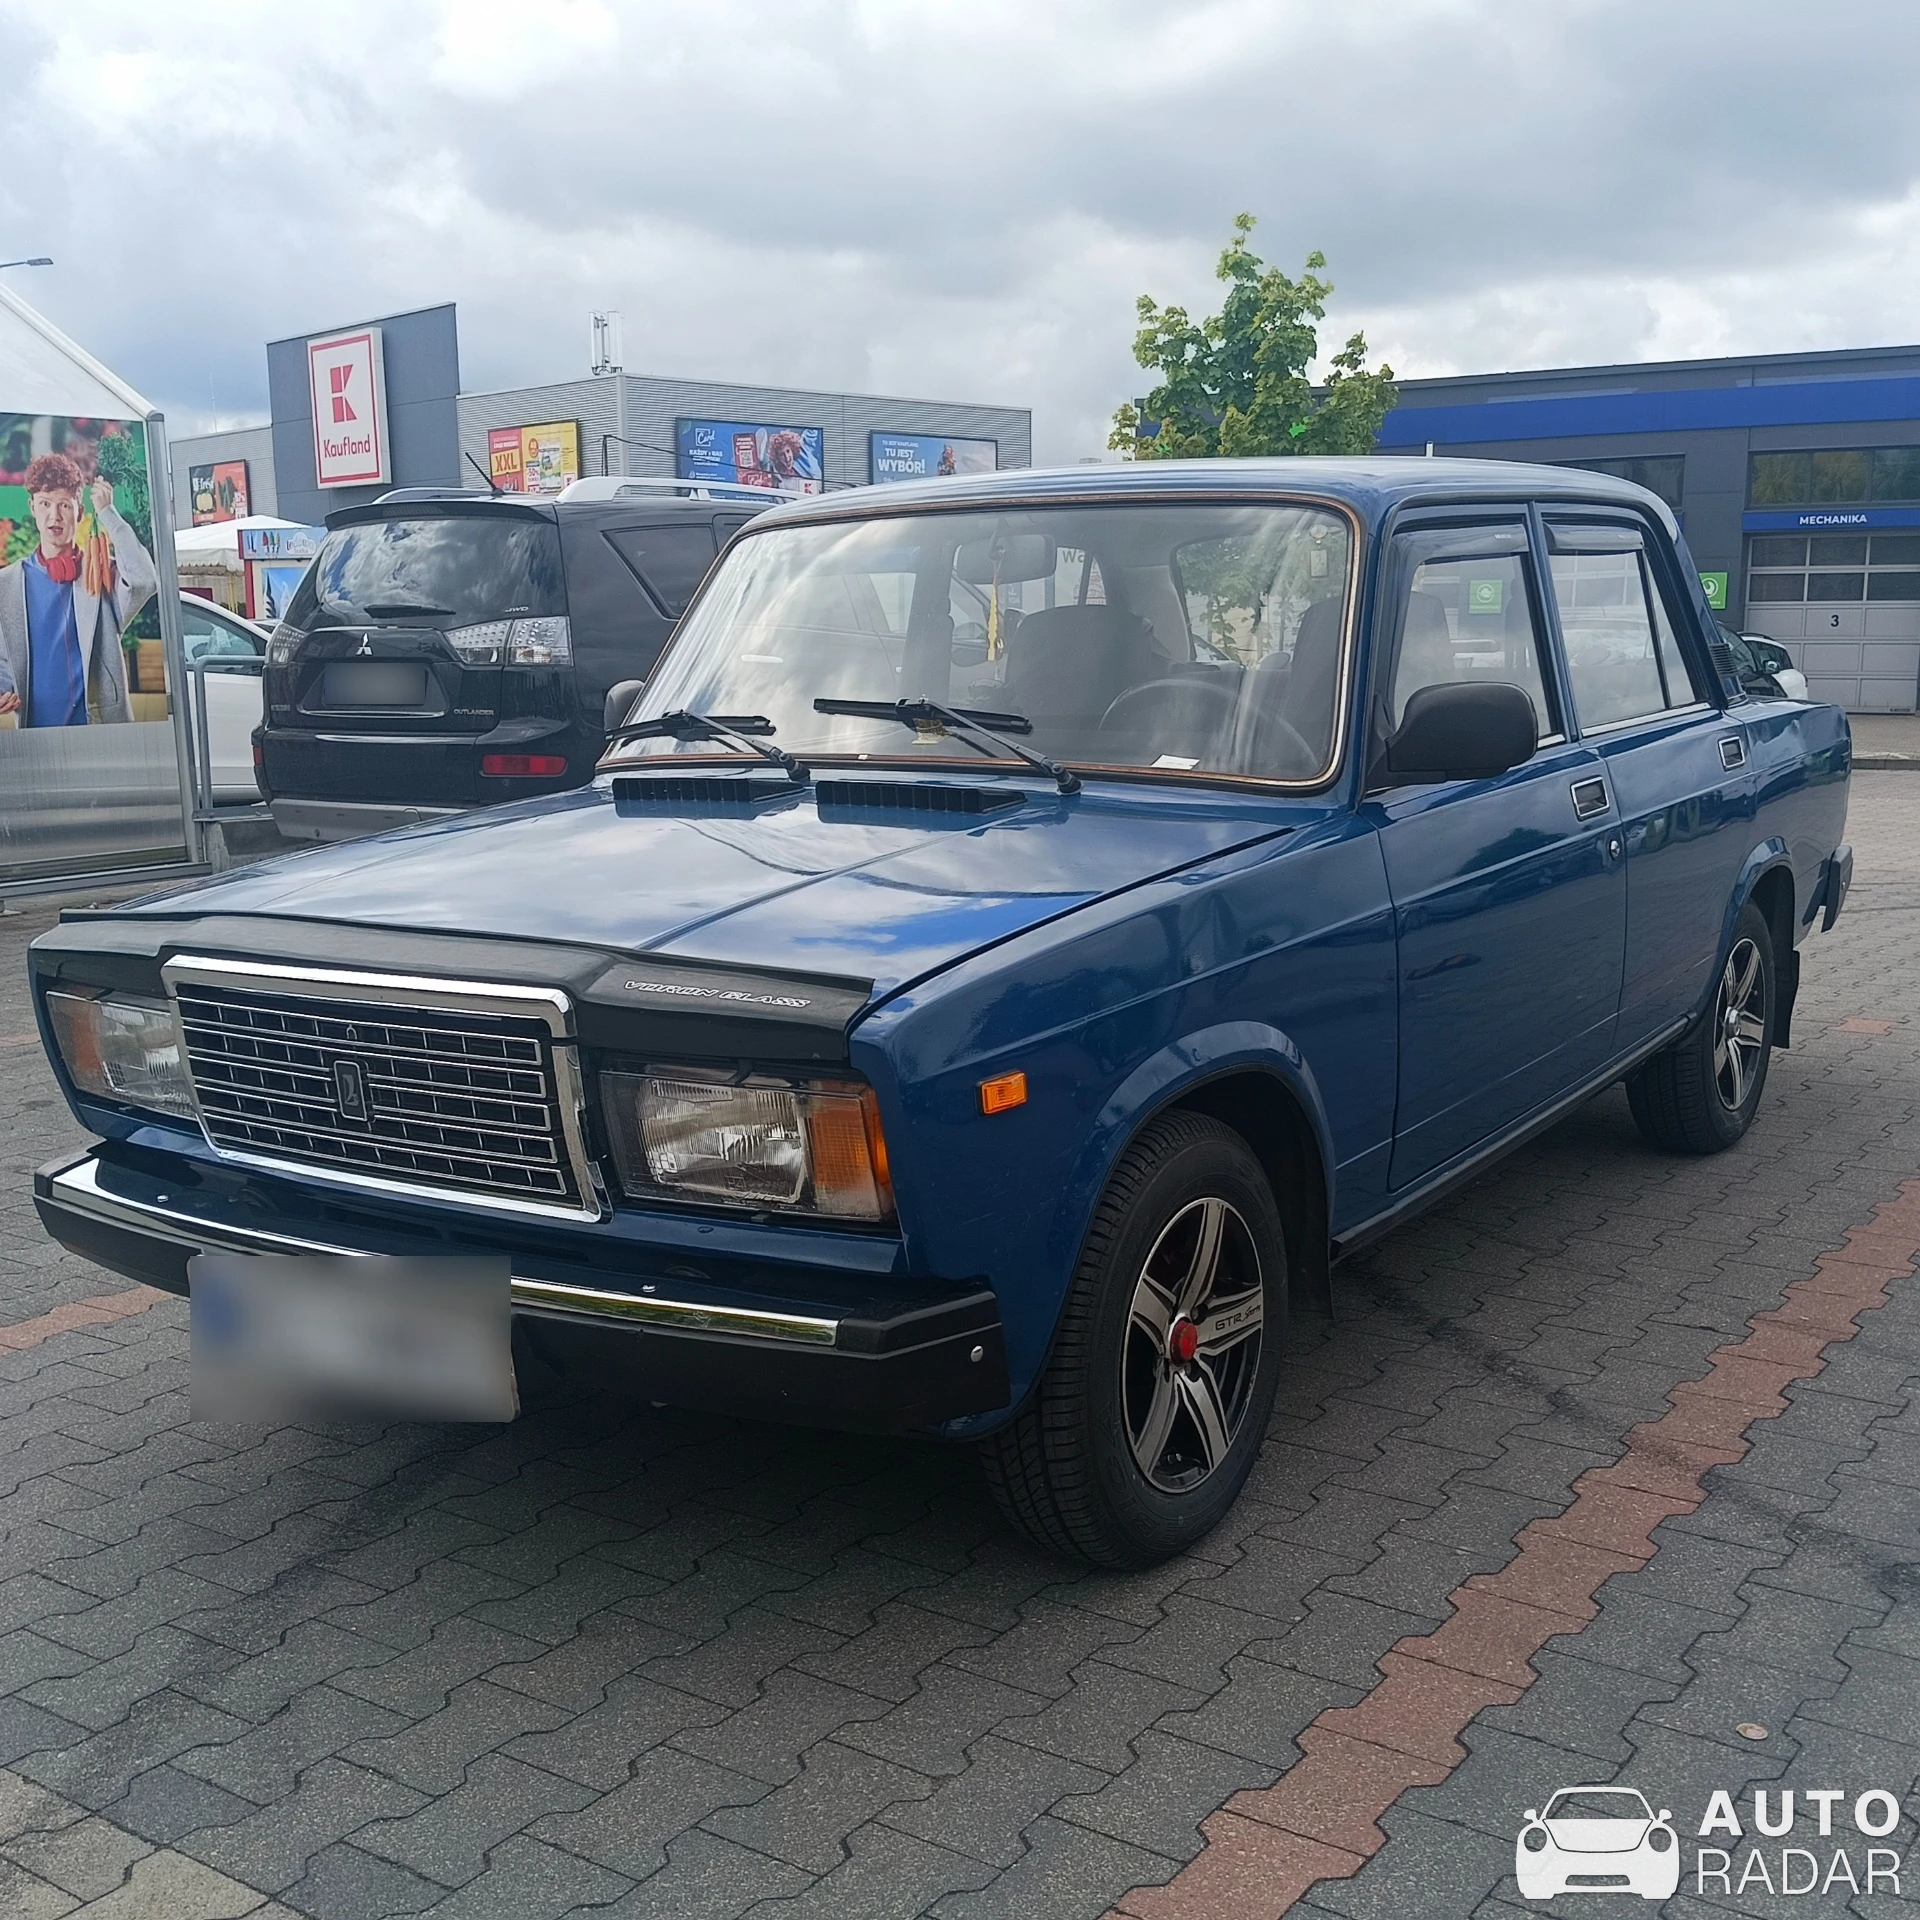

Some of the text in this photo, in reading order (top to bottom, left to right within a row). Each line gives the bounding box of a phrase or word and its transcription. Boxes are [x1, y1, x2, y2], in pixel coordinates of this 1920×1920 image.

[323, 434, 371, 459] Kaufland
[884, 448, 915, 460] TU JEST
[495, 452, 518, 473] XXL
[877, 457, 926, 474] WYBÓR!
[1799, 514, 1868, 525] MECHANIKA
[1830, 614, 1840, 628] 3
[453, 708, 495, 716] OUTLANDER
[1215, 1312, 1242, 1331] GTR
